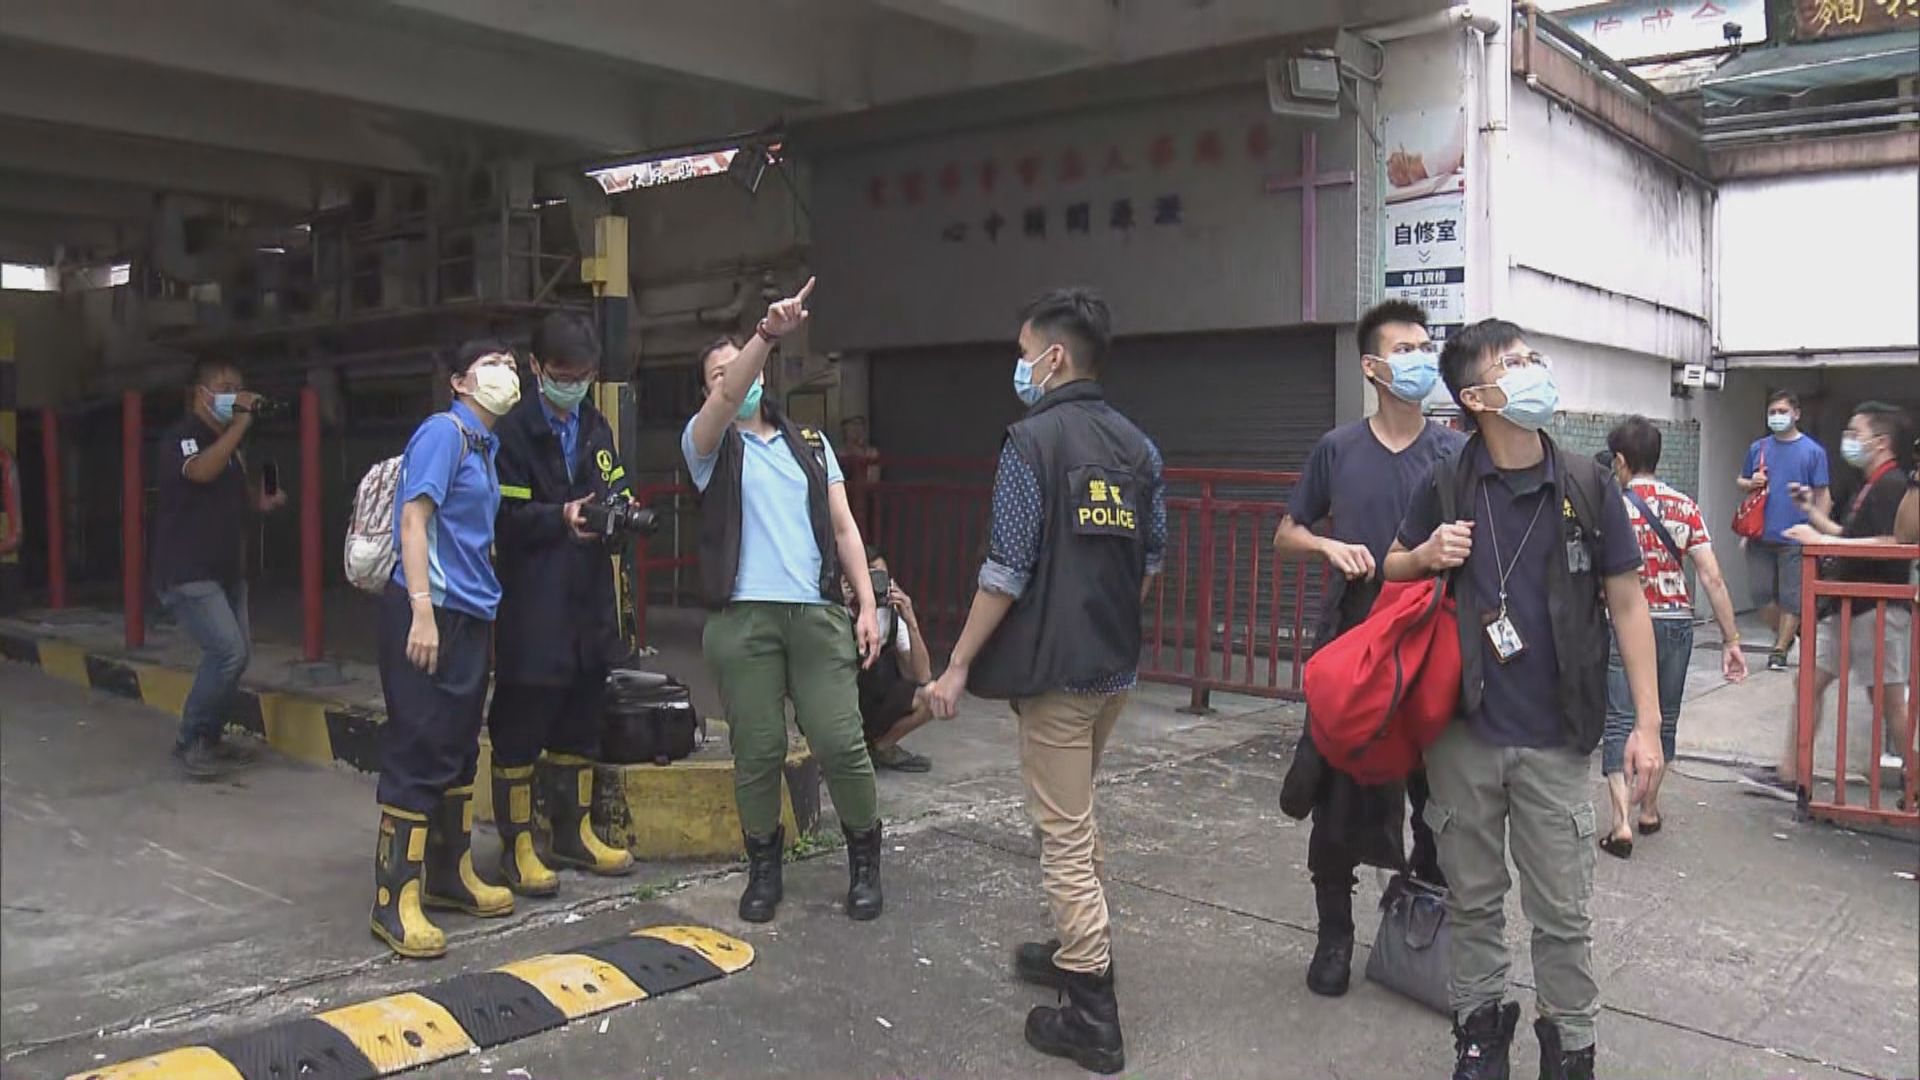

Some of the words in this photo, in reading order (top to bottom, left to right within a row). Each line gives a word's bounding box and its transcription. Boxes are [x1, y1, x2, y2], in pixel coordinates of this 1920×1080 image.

[1395, 219, 1457, 246] 自修室
[1078, 507, 1136, 530] POLICE
